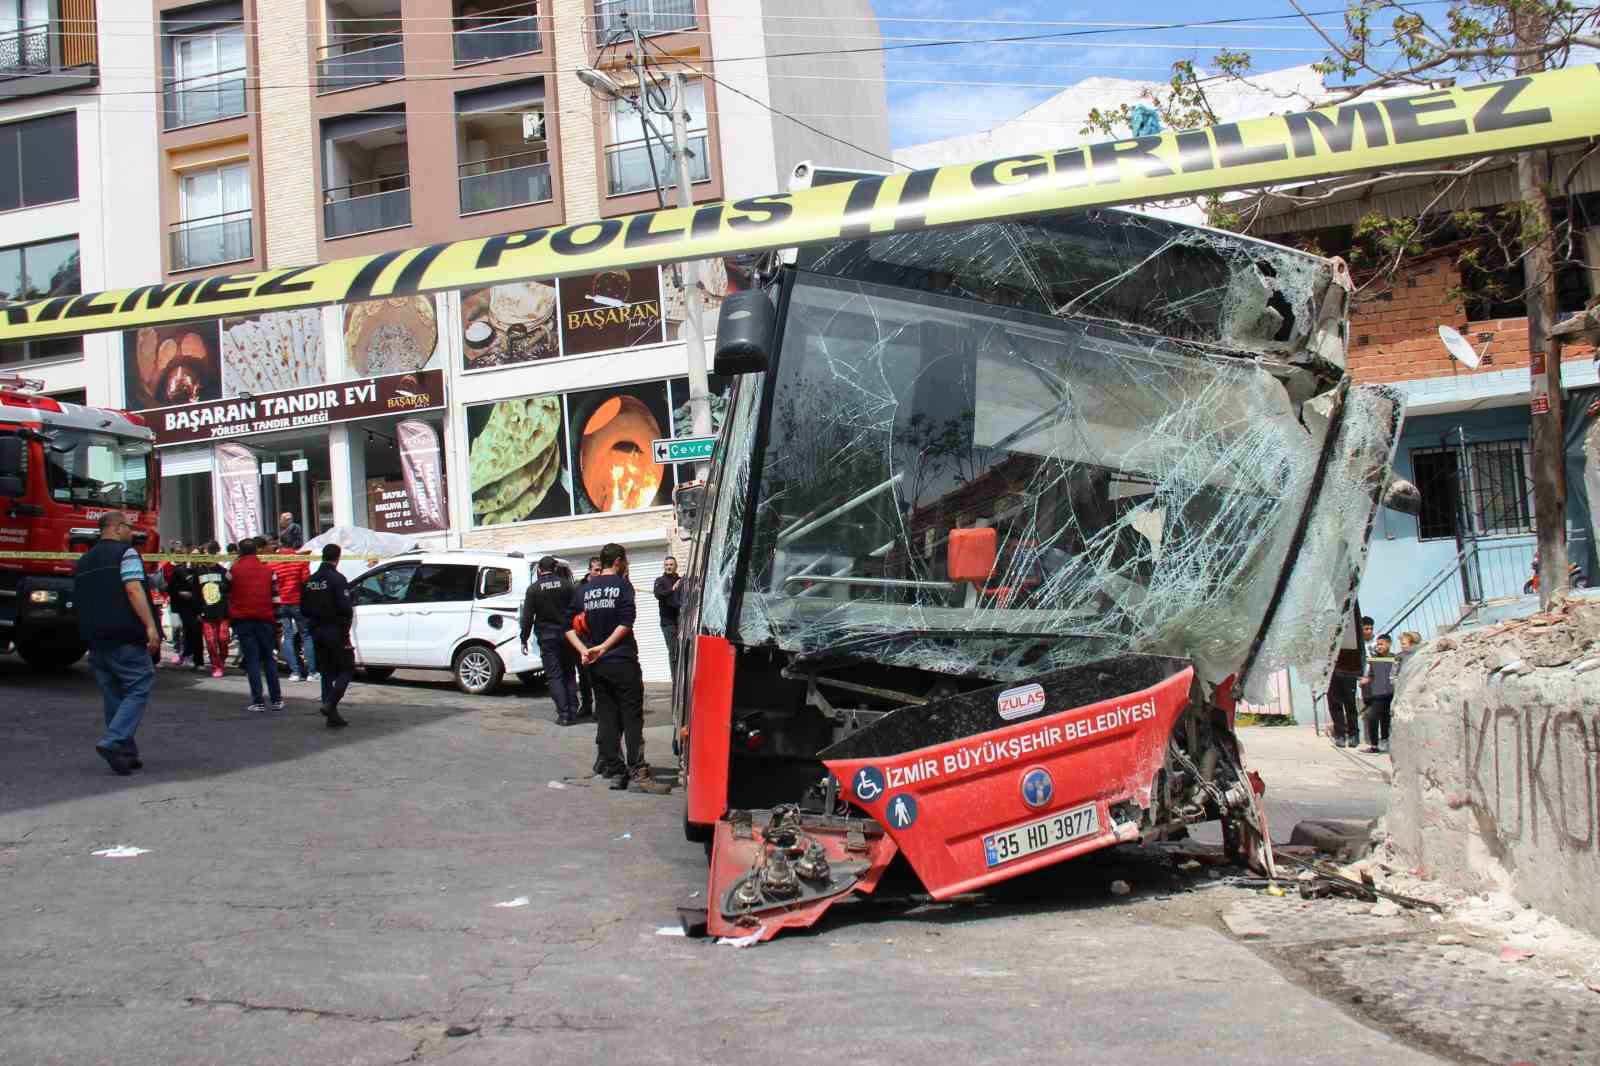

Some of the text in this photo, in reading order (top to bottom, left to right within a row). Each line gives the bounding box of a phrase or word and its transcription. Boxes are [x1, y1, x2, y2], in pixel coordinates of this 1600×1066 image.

[475, 193, 793, 269] POLİS
[970, 77, 1552, 196] GİRİLMEZ
[567, 303, 659, 330] BAŞARAN
[165, 380, 377, 432] BAŞARAN TANDIR EVİ
[210, 410, 329, 437] YÖRESEL TANDIR EKMEĞİ
[671, 444, 712, 457] Çevre
[584, 587, 602, 600] AKS
[886, 696, 1157, 789] İZMİR BÜYÜKŞEHİR BELEDİYESİ
[998, 809, 1093, 859] 35 HD 3877
